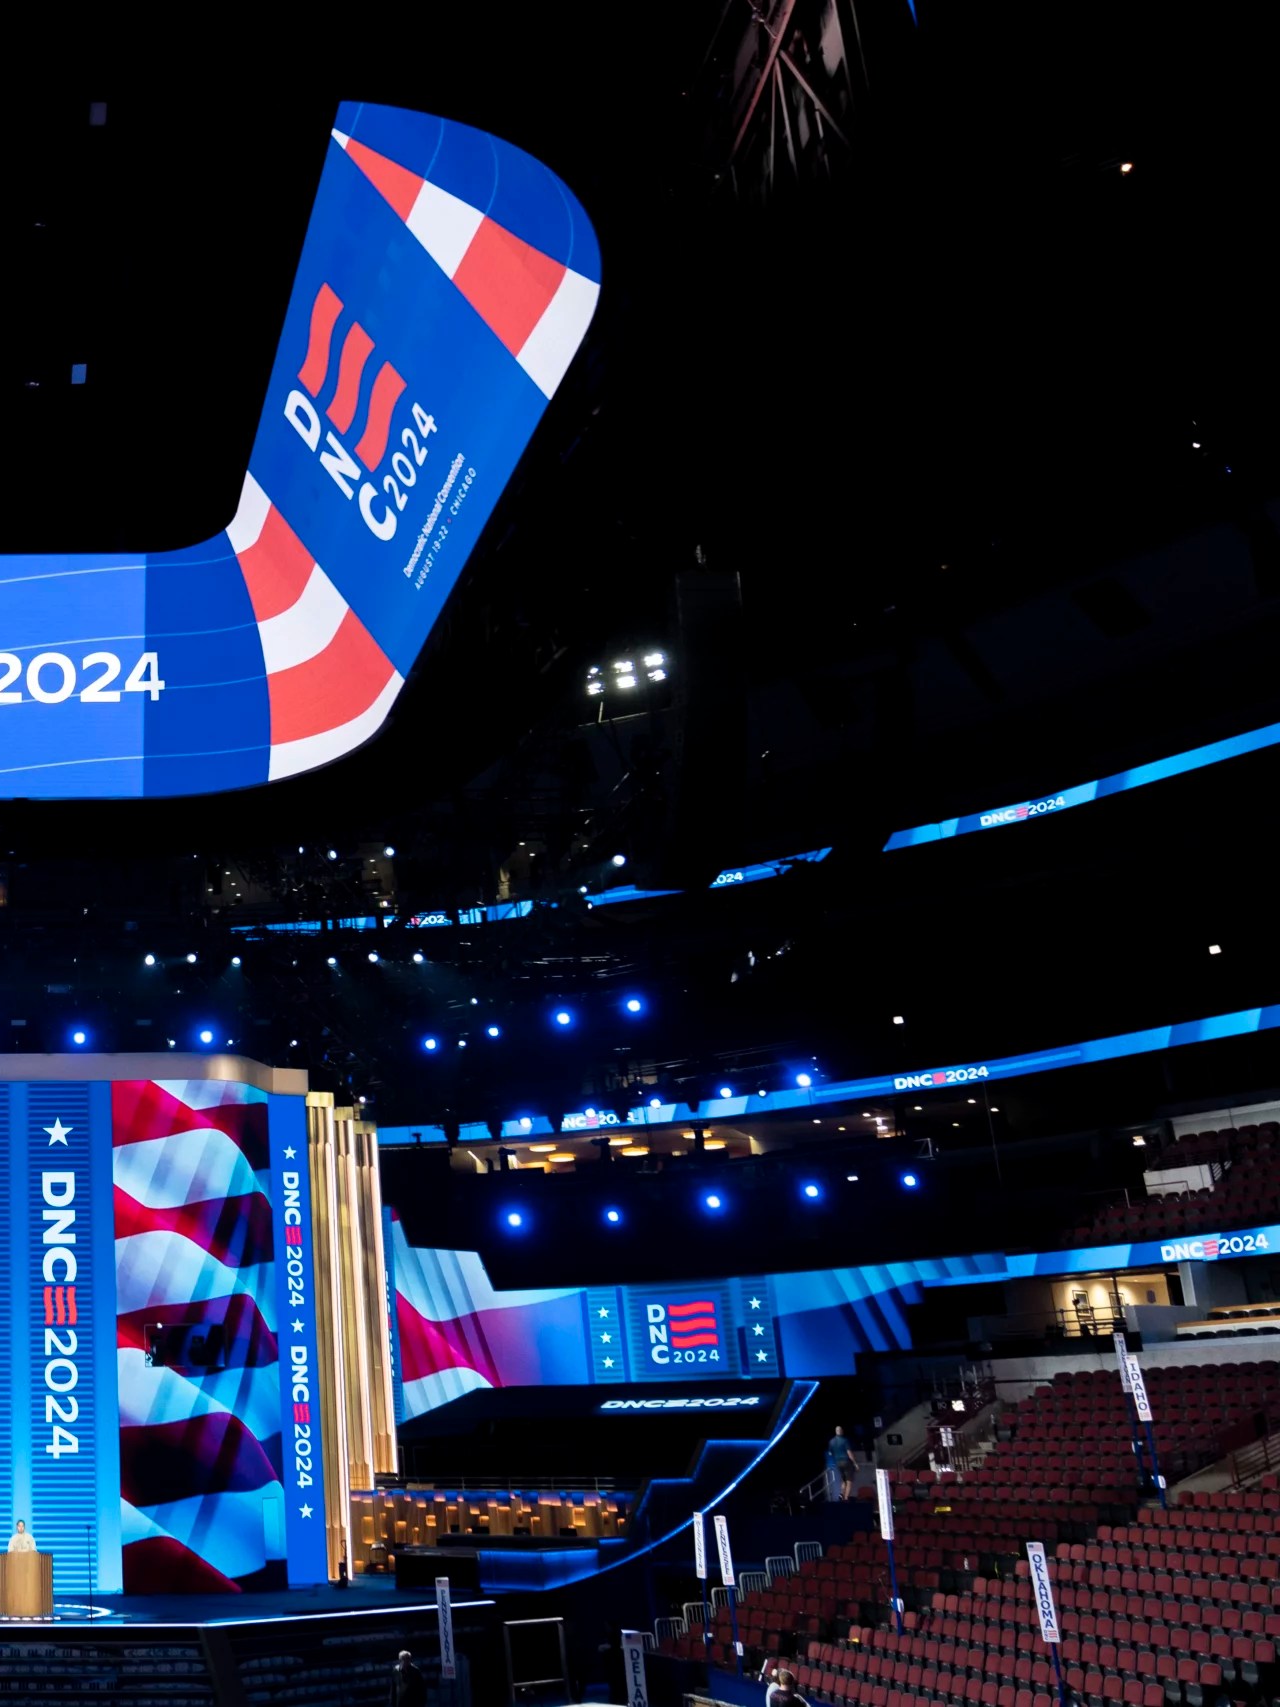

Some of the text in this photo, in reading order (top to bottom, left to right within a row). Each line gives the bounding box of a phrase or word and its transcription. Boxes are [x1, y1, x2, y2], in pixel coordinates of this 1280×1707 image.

[284, 389, 398, 541] DNC
[383, 402, 438, 512] 2024
[414, 467, 477, 591] AUGUST 19-22 CHICAGO
[1027, 796, 1065, 815] 2024
[712, 872, 744, 885] 024
[945, 1066, 989, 1083] 2024
[1218, 1233, 1269, 1254] 2024
[286, 1246, 305, 1307] 2024
[673, 1349, 720, 1363] 2024
[44, 1328, 79, 1459] 2024
[1129, 1363, 1148, 1411] IDAHO
[294, 1424, 313, 1489] 2024
[1032, 1553, 1054, 1629] OKLAHOMA
